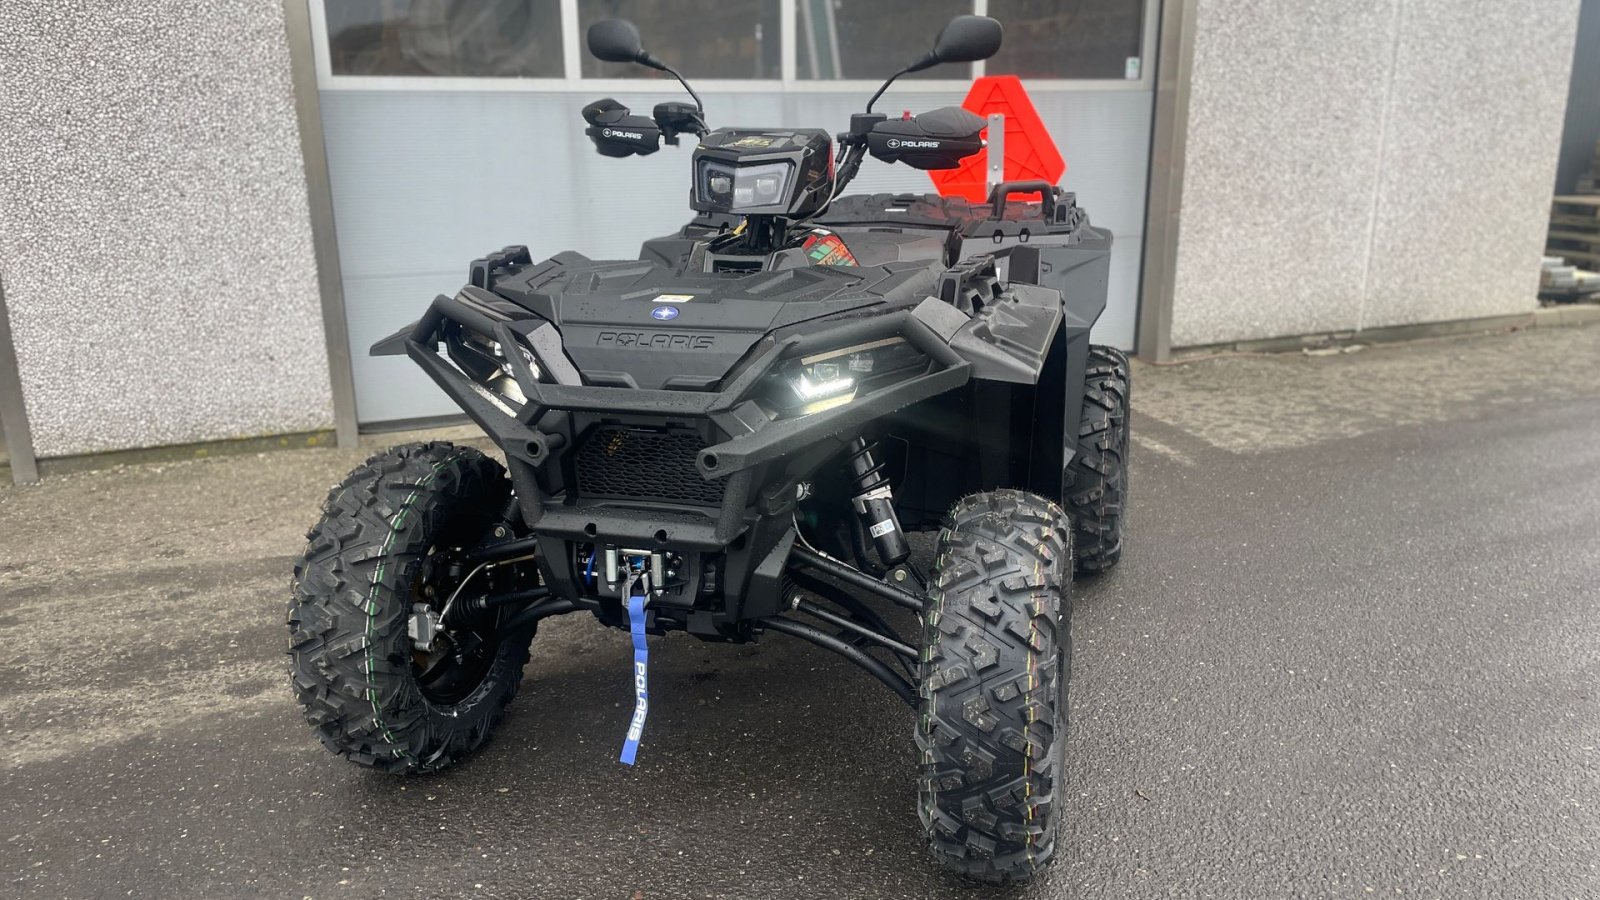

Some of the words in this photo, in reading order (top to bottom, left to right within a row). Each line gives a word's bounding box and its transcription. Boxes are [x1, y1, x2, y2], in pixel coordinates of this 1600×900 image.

[612, 130, 643, 139] POLARIS
[596, 331, 715, 350] POLARIS
[629, 662, 647, 741] POLARIS
